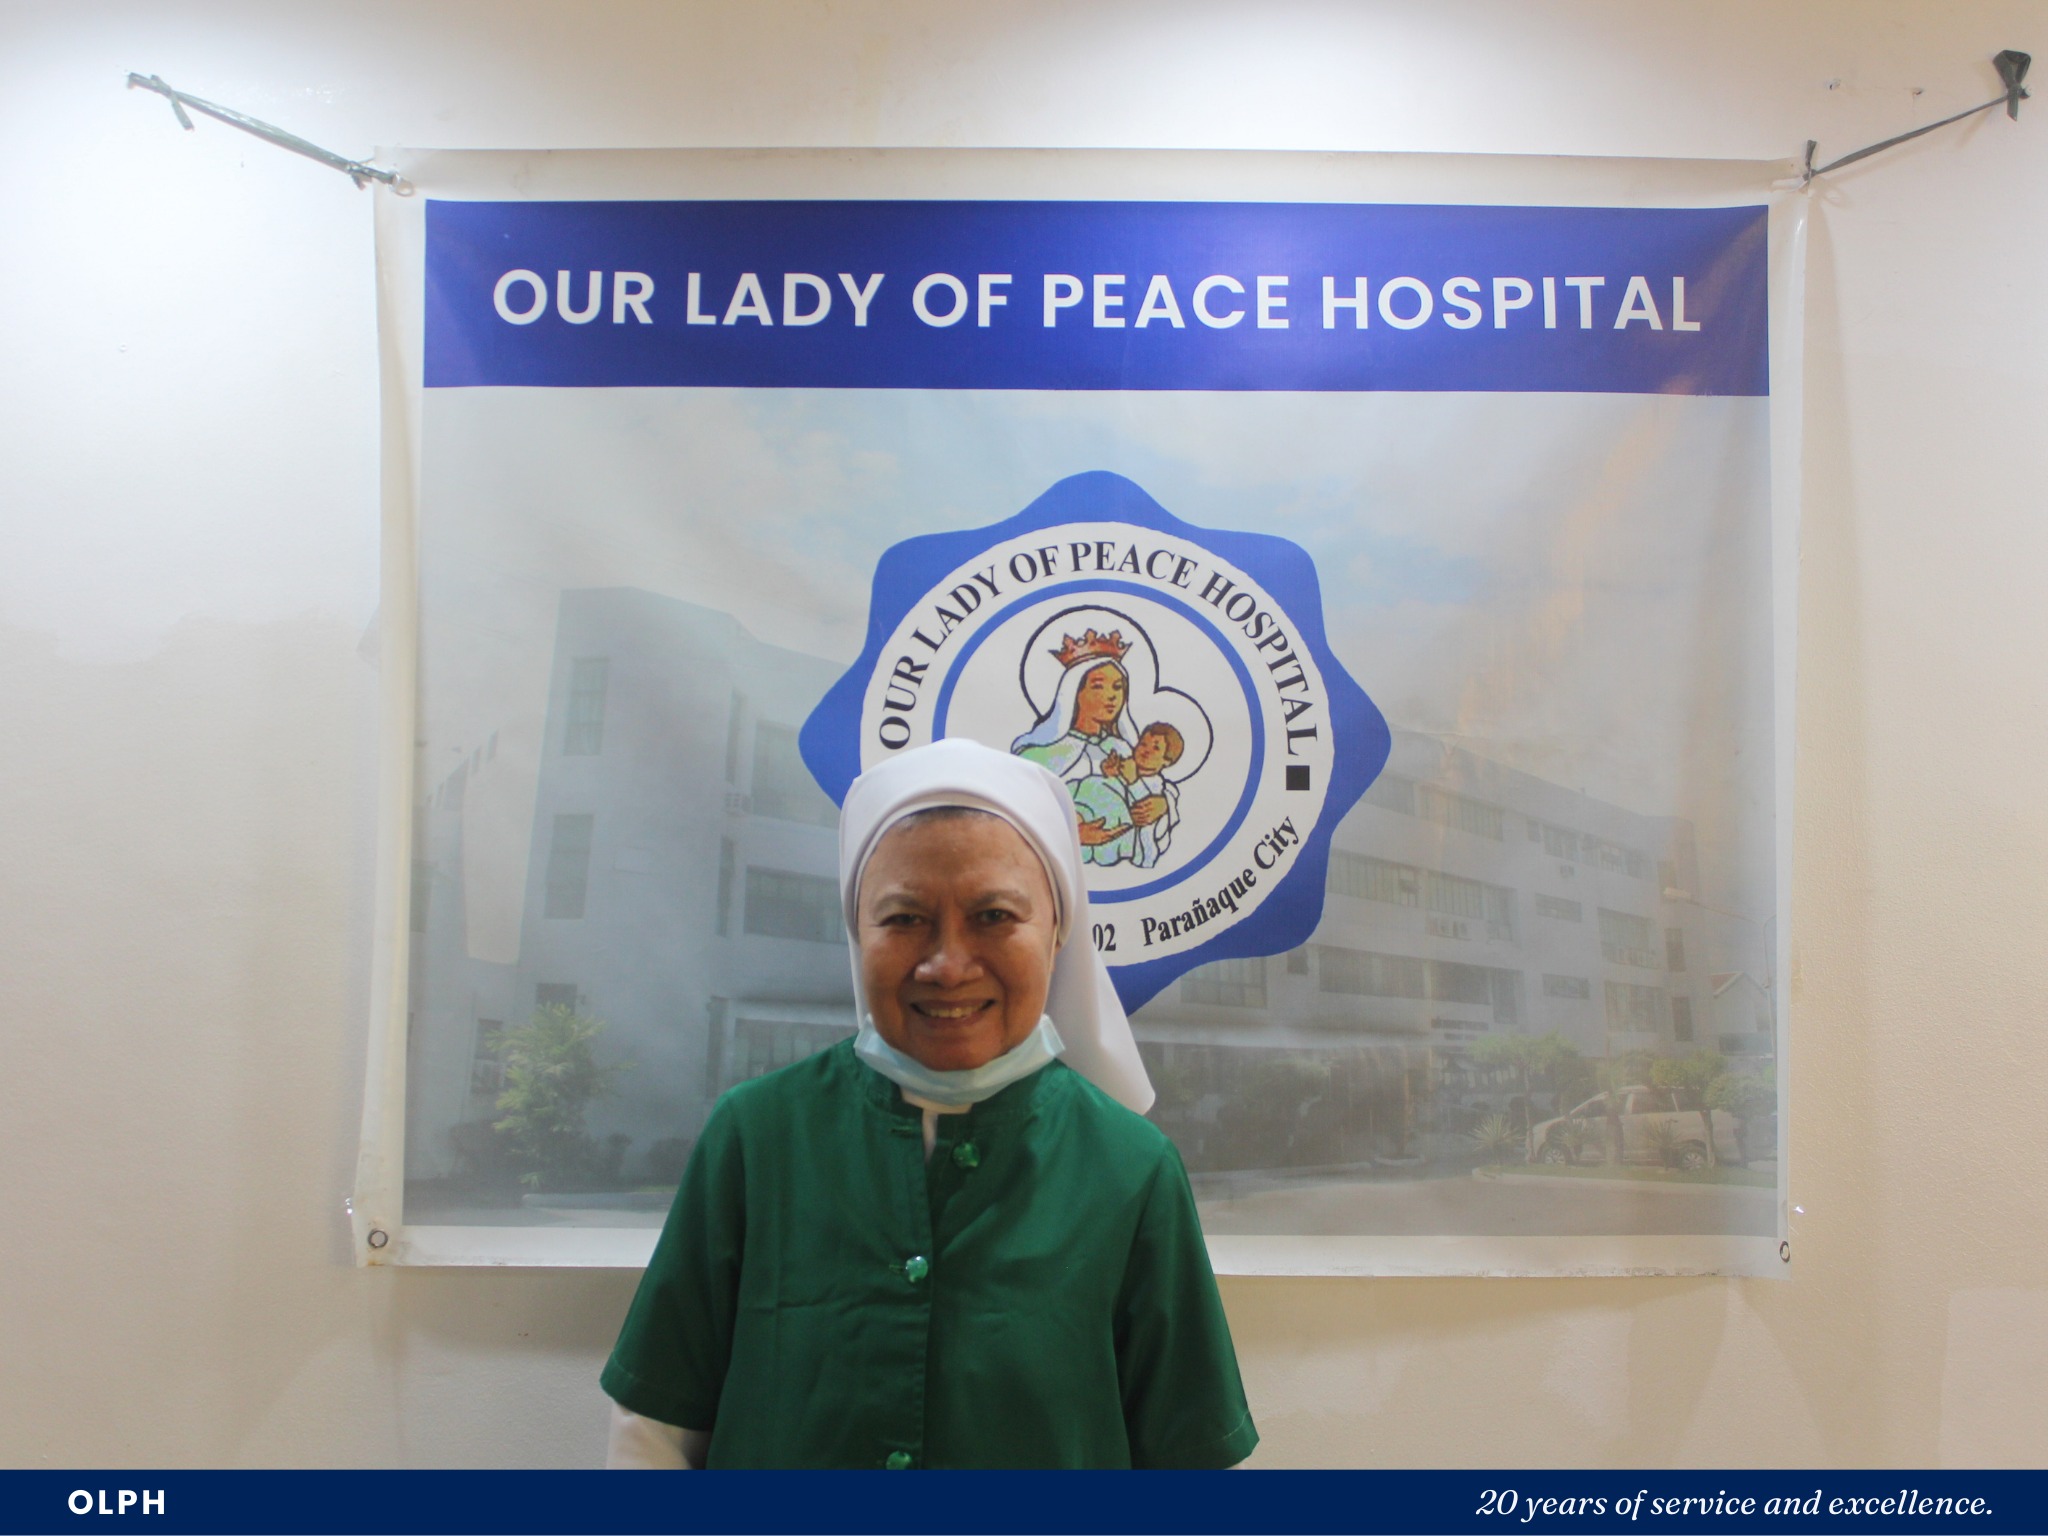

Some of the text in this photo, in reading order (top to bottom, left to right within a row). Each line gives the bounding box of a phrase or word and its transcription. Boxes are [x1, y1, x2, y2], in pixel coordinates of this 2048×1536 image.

[492, 268, 1704, 333] OUR LADY OF PEACE HOSPITAL
[878, 541, 1319, 756] OUR LADY OF PEACE HOSPITAL
[1140, 868, 1258, 948] Parañaque
[1253, 815, 1300, 871] City
